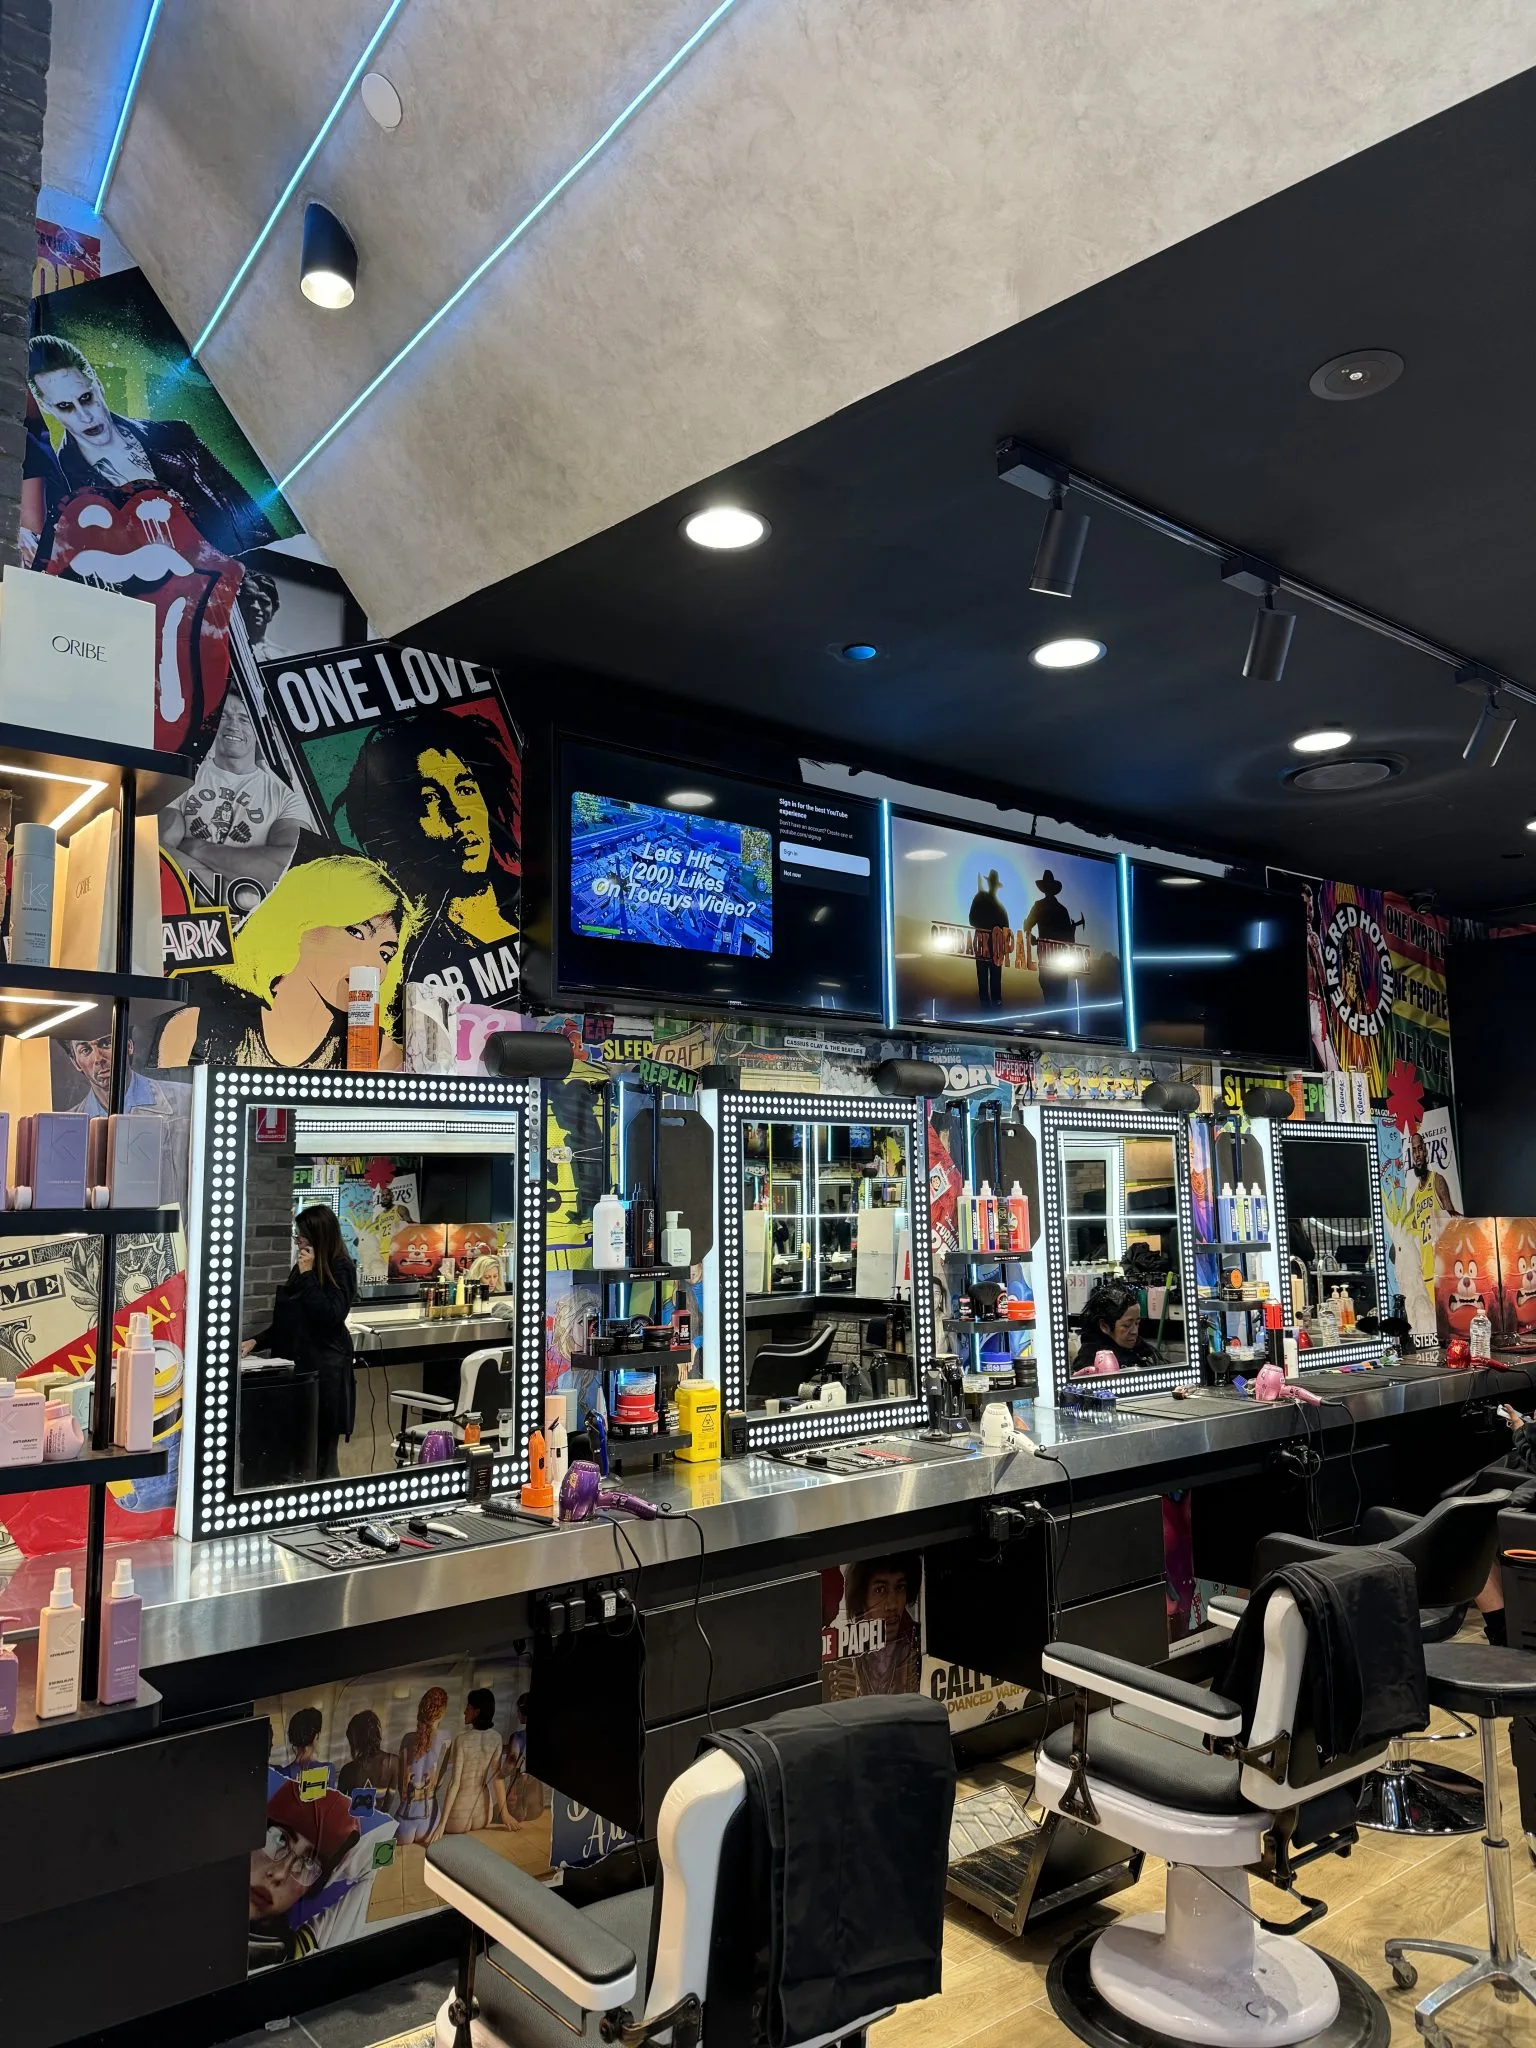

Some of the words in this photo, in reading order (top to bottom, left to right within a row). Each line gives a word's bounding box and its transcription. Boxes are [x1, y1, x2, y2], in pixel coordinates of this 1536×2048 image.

[52, 635, 108, 664] ORIBE
[277, 658, 381, 733] ONE
[374, 646, 492, 712] LOVE
[184, 786, 265, 825] WORLD
[779, 798, 791, 807] Sign
[798, 801, 806, 809] for
[806, 803, 814, 812] the
[814, 805, 826, 814] best
[826, 808, 848, 819] YouTube
[779, 808, 808, 820] experience
[642, 842, 684, 866] Lets
[686, 849, 713, 870] Hit
[784, 869, 792, 877] Not
[188, 869, 279, 916] NO
[629, 861, 675, 889] (200)
[678, 870, 725, 894] Likes
[591, 877, 620, 898] On
[627, 882, 694, 913] Todays
[699, 892, 757, 918] Video?
[1328, 906, 1358, 945] RED
[1359, 911, 1389, 952] HOT
[1386, 905, 1409, 941] ONE
[1409, 914, 1447, 961] WORLD
[992, 925, 1038, 971] OPAL
[468, 941, 520, 999] MA
[1325, 945, 1379, 1037] PEPPERS
[1373, 953, 1394, 1028] CHILI
[1410, 976, 1448, 1020] PEOPLE
[584, 1015, 614, 1040] EAT
[602, 1038, 653, 1061] SLEEP
[654, 1040, 707, 1068] CRAFT
[786, 1038, 810, 1048] CASSIUS
[810, 1041, 823, 1050] CLAY
[841, 1046, 864, 1055] BEATLES
[928, 1055, 962, 1064] FINDING
[1415, 1036, 1450, 1080] LOVE
[639, 1057, 698, 1095] REPEAT
[940, 1064, 1000, 1091] ORY
[996, 1060, 1034, 1077] UPPERCUT
[1338, 1079, 1346, 1116] Kleenex
[1357, 1080, 1365, 1116] Kleenex
[1401, 1137, 1451, 1171] AERS
[838, 1617, 886, 1658] PAPEL
